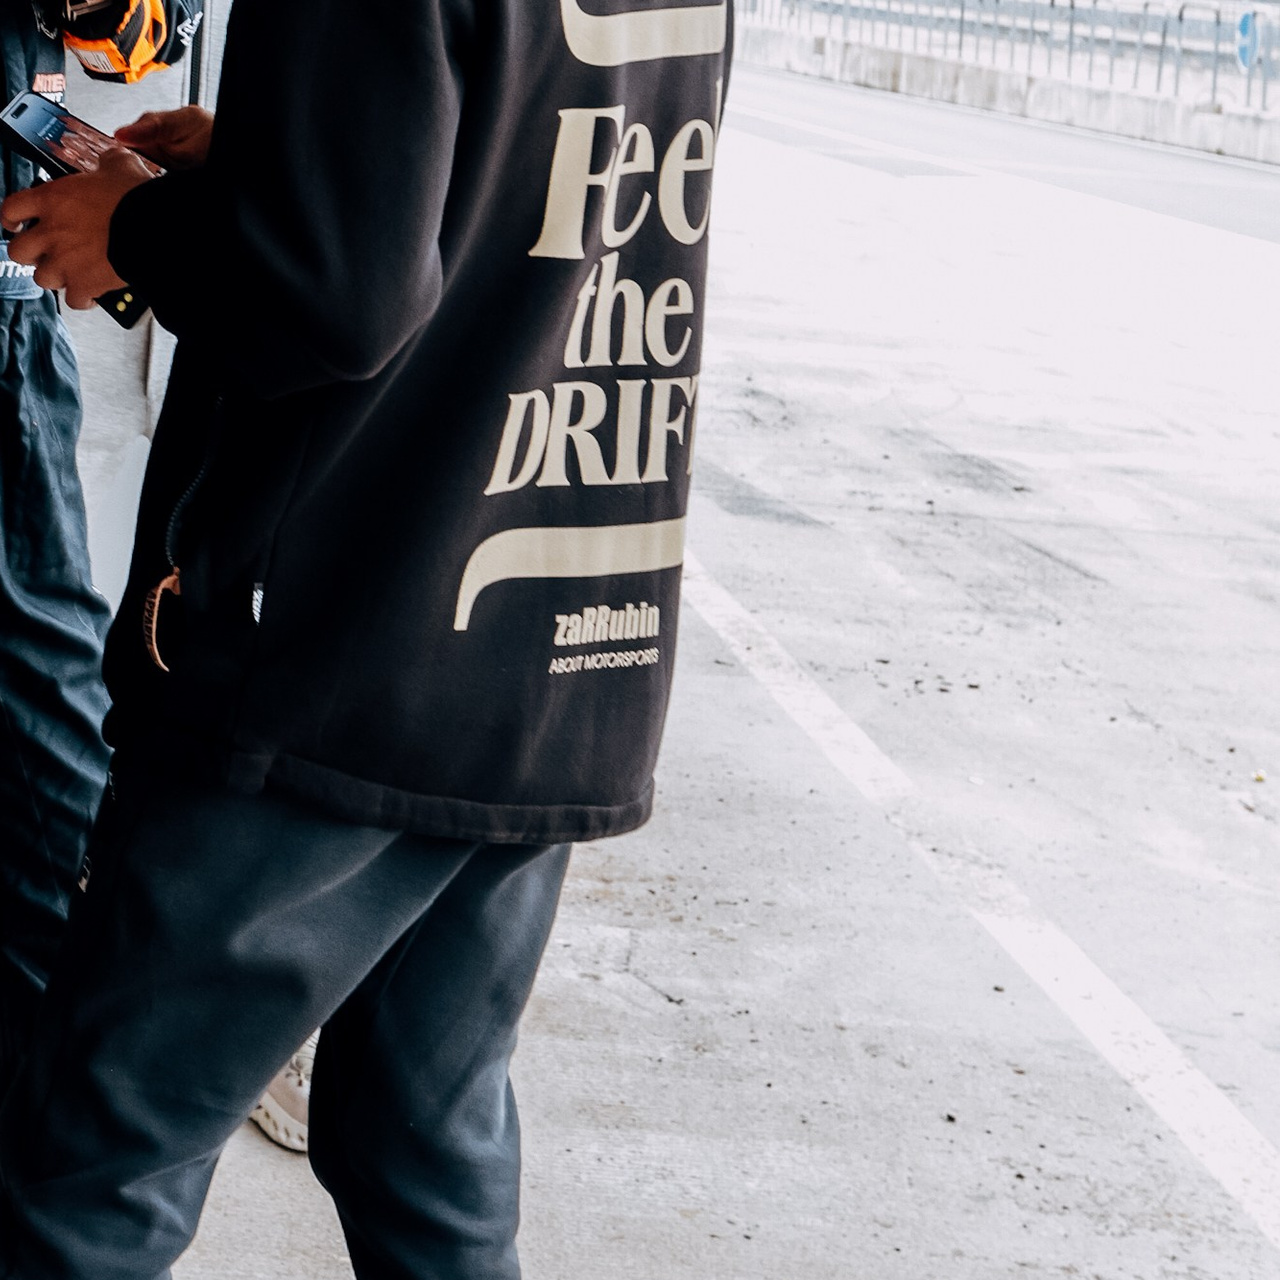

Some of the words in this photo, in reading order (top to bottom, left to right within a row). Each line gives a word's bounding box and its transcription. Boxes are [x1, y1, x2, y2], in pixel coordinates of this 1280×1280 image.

[564, 251, 694, 368] the
[548, 654, 585, 674] ABOUT
[584, 647, 660, 671] MOTORSPORTS
